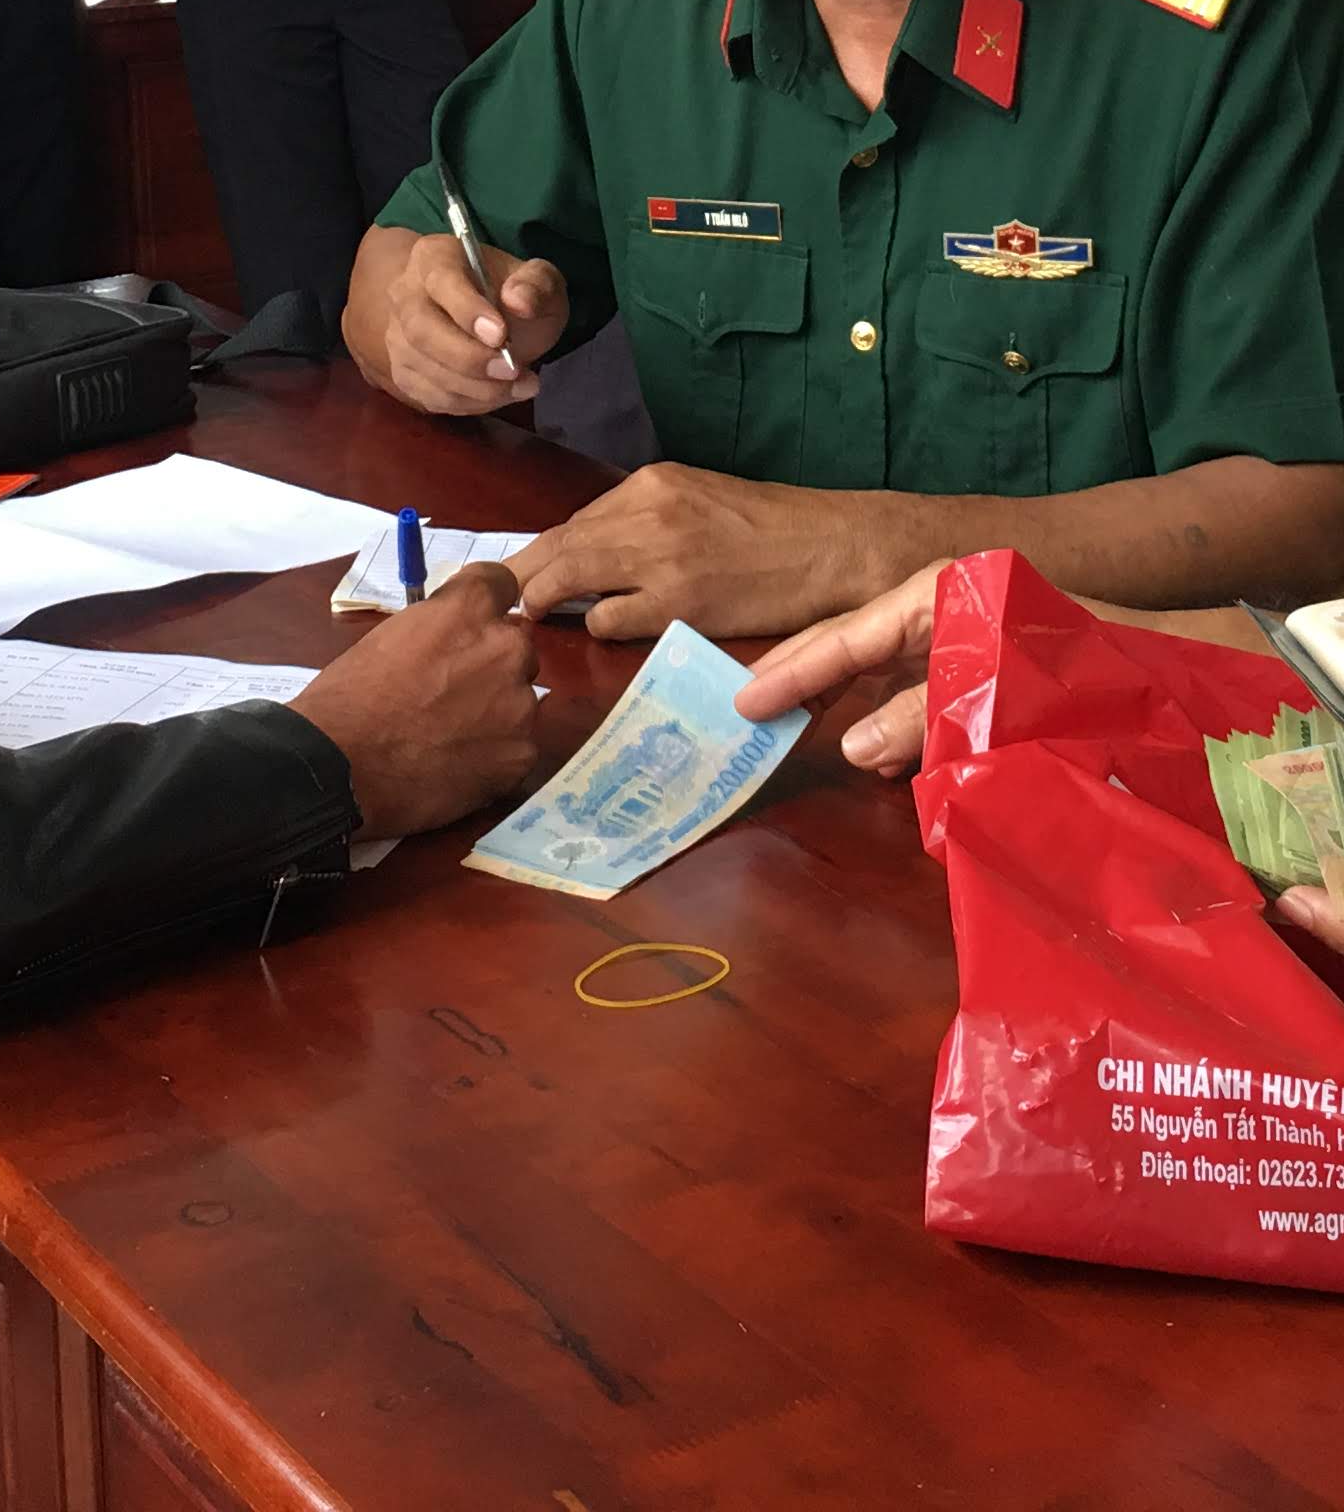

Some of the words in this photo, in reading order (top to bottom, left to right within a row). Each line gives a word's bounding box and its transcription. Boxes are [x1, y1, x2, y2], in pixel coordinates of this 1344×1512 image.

[708, 724, 777, 802] 20000
[1097, 1057, 1144, 1094] CHI
[1153, 1056, 1252, 1101] NHÁNH
[1111, 1103, 1135, 1133] 55
[1140, 1105, 1218, 1144] Nguyễn
[1222, 1106, 1257, 1141] Tất
[1261, 1114, 1332, 1153] Thành,
[1140, 1150, 1188, 1186] Điện
[1192, 1155, 1252, 1191] thoại:
